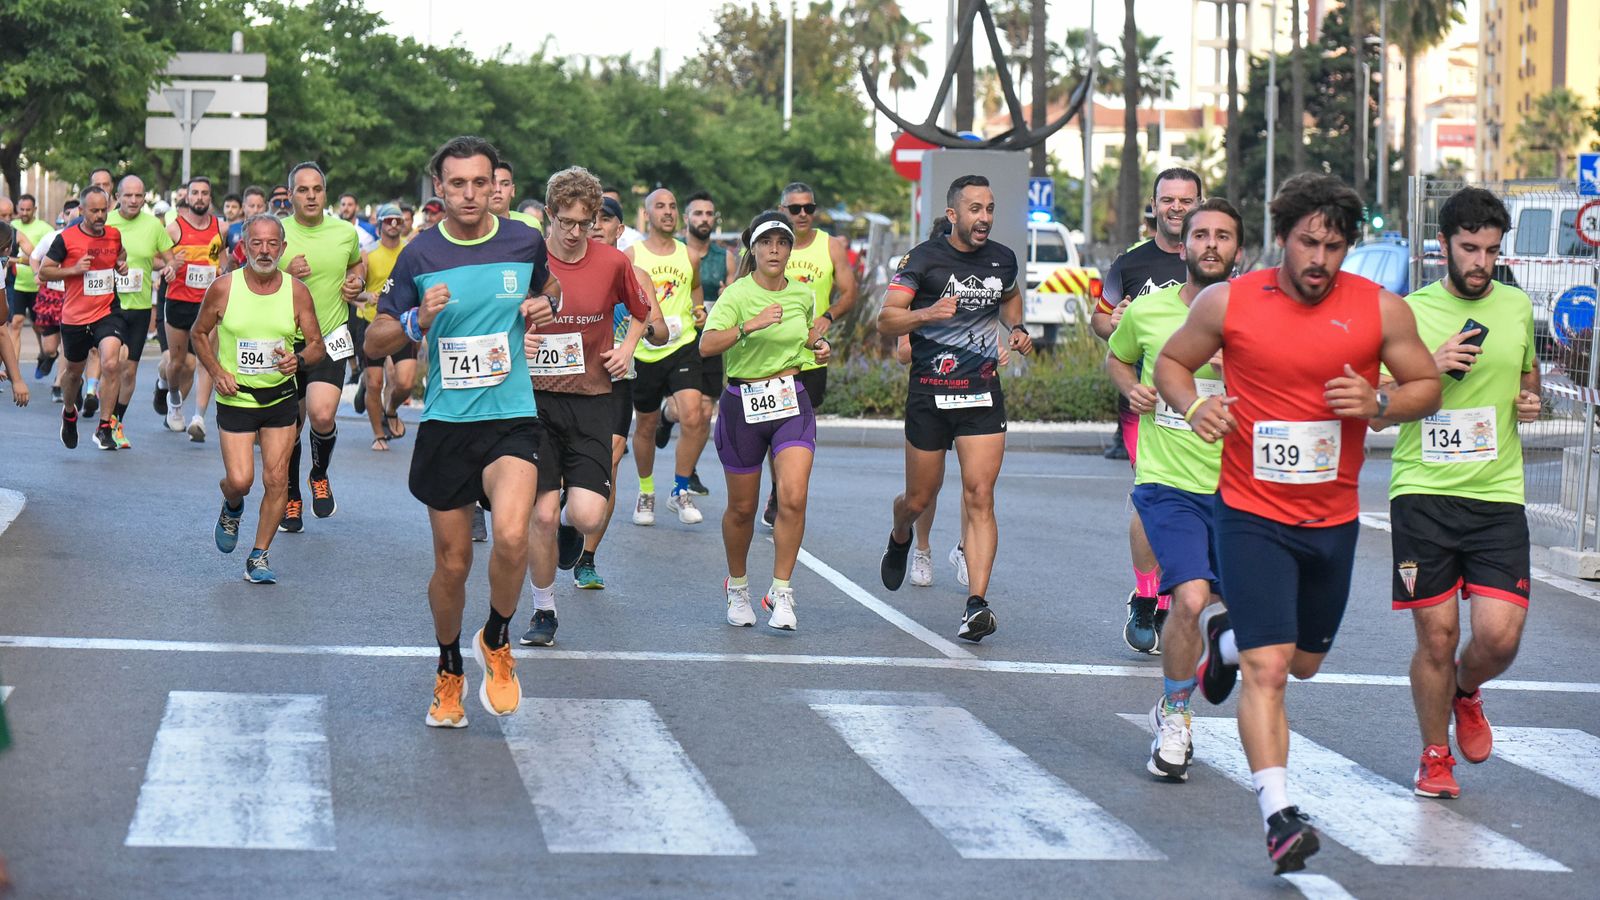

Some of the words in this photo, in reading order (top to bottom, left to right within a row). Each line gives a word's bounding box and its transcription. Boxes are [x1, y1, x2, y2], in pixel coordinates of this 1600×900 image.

[651, 266, 687, 284] GECIRAS
[785, 261, 824, 278] GECIRAS
[88, 279, 103, 288] 828
[188, 273, 203, 282] 615
[957, 298, 994, 306] RAIL
[552, 315, 574, 324] MATE
[576, 313, 604, 325] SEVILLA
[329, 338, 347, 351] 849
[241, 351, 264, 365] 594
[449, 355, 479, 374] 741
[929, 378, 969, 386] RECAMBIO
[750, 394, 776, 412] 848
[1428, 428, 1461, 448] 134
[1262, 443, 1300, 466] 139
